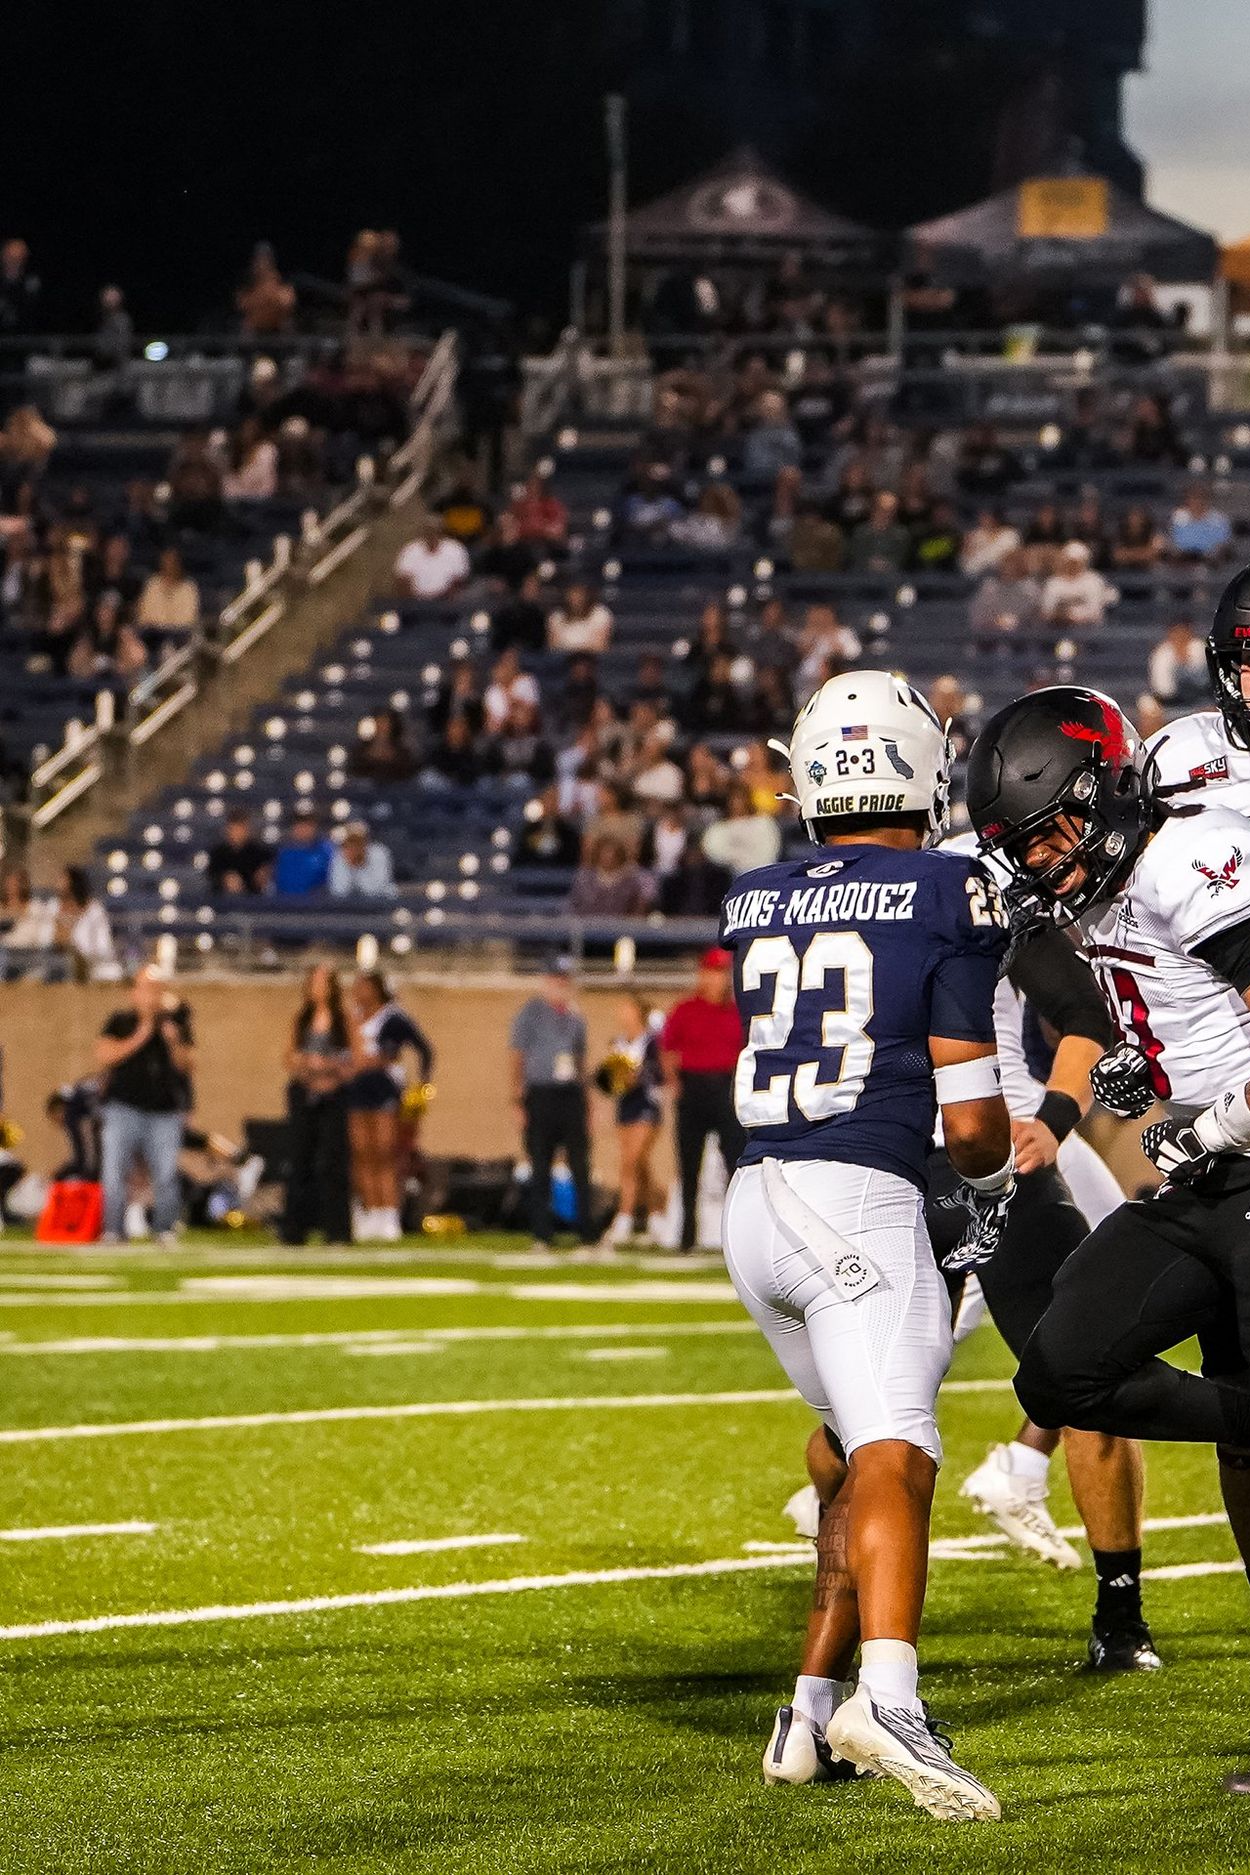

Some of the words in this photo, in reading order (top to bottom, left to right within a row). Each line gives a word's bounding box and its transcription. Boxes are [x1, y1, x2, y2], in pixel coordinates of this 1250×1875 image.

[1205, 757, 1227, 774] SKY
[816, 796, 853, 816] AGGIE
[859, 793, 905, 812] PRIDE
[734, 931, 876, 1128] 23
